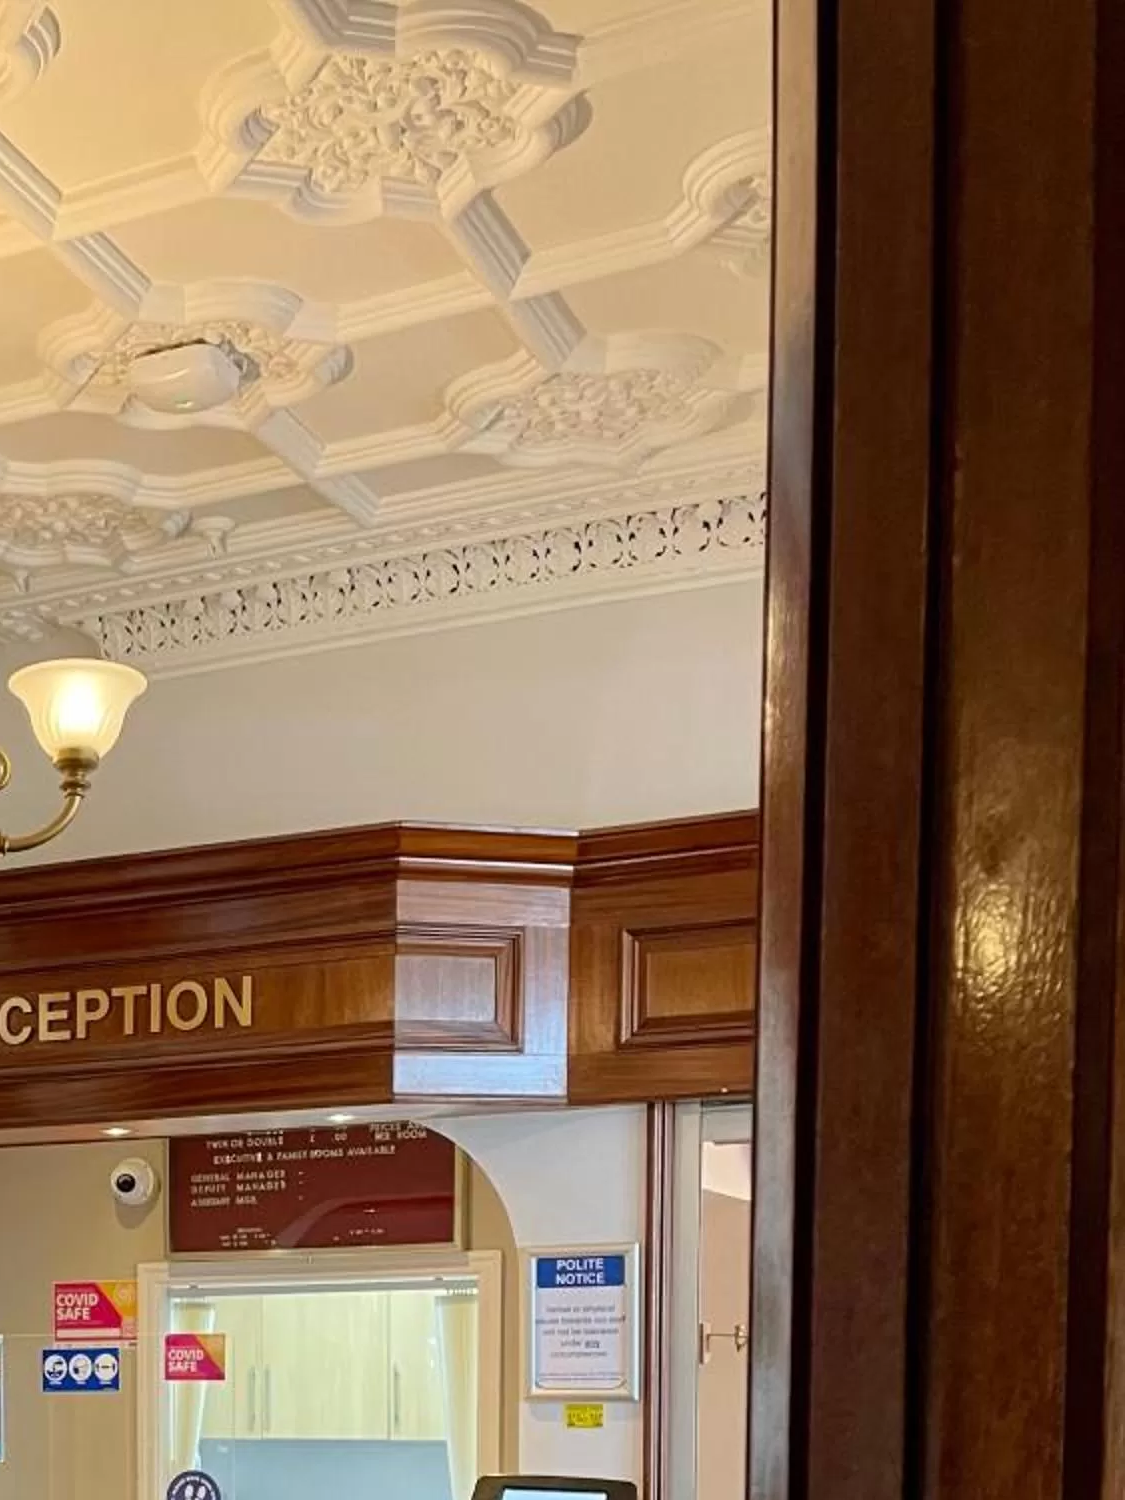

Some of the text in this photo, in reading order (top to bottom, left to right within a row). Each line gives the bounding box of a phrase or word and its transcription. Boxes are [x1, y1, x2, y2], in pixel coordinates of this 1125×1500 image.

[236, 1169, 286, 1181] MANAGER
[236, 1180, 286, 1192] MANAGER
[556, 1258, 604, 1271] POLITE
[556, 1272, 605, 1285] NOTICE
[56, 1293, 99, 1307] COVID
[56, 1307, 91, 1321] SAFE
[168, 1348, 204, 1361] COVID
[168, 1361, 197, 1373] SAFE
